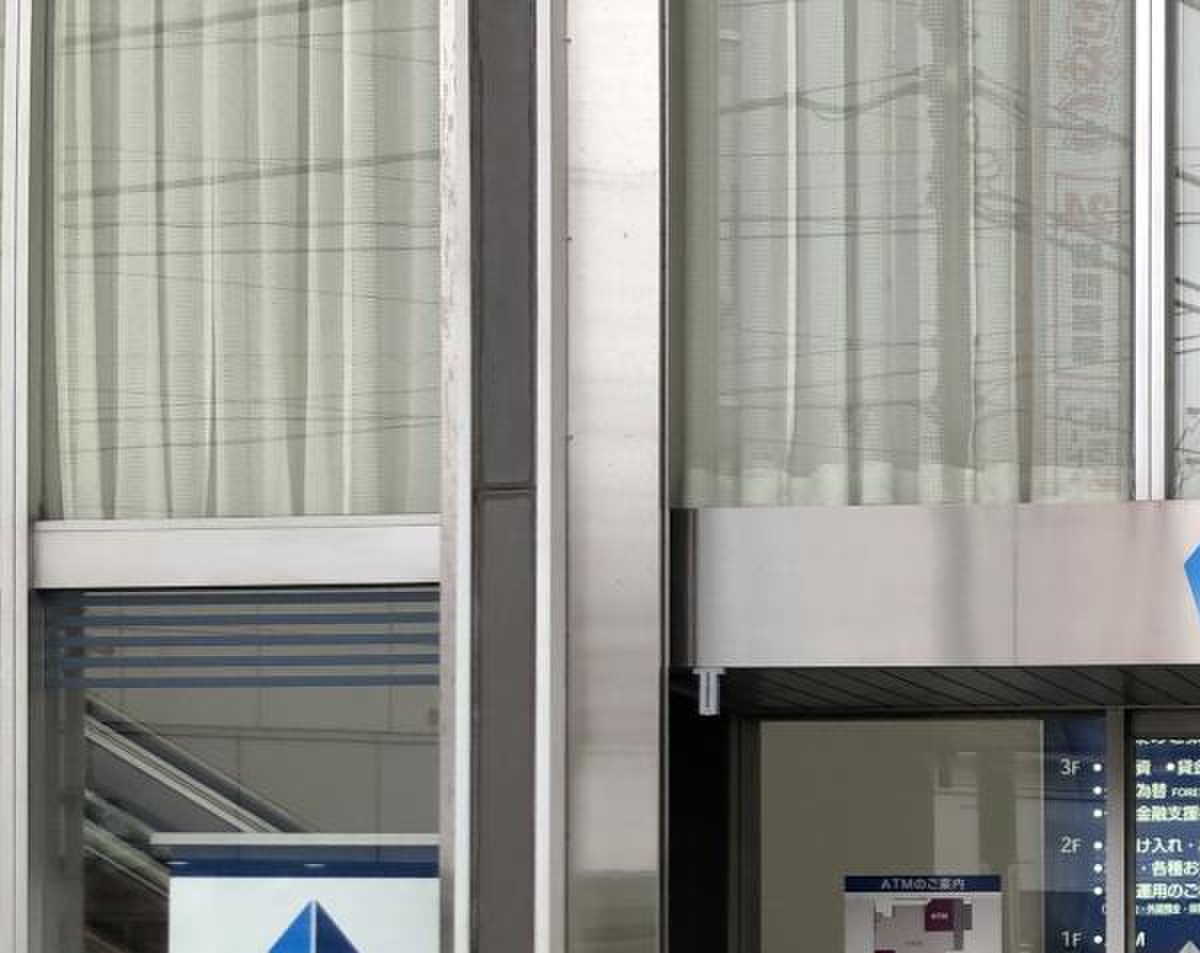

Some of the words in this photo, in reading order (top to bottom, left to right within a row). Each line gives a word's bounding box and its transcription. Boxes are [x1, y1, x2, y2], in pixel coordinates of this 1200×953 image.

[1060, 758, 1081, 775] 3F
[1135, 783, 1167, 799] 為替
[1060, 836, 1082, 853] 2F
[881, 877, 965, 890] ATMのご案内
[1061, 931, 1082, 948] 1F
